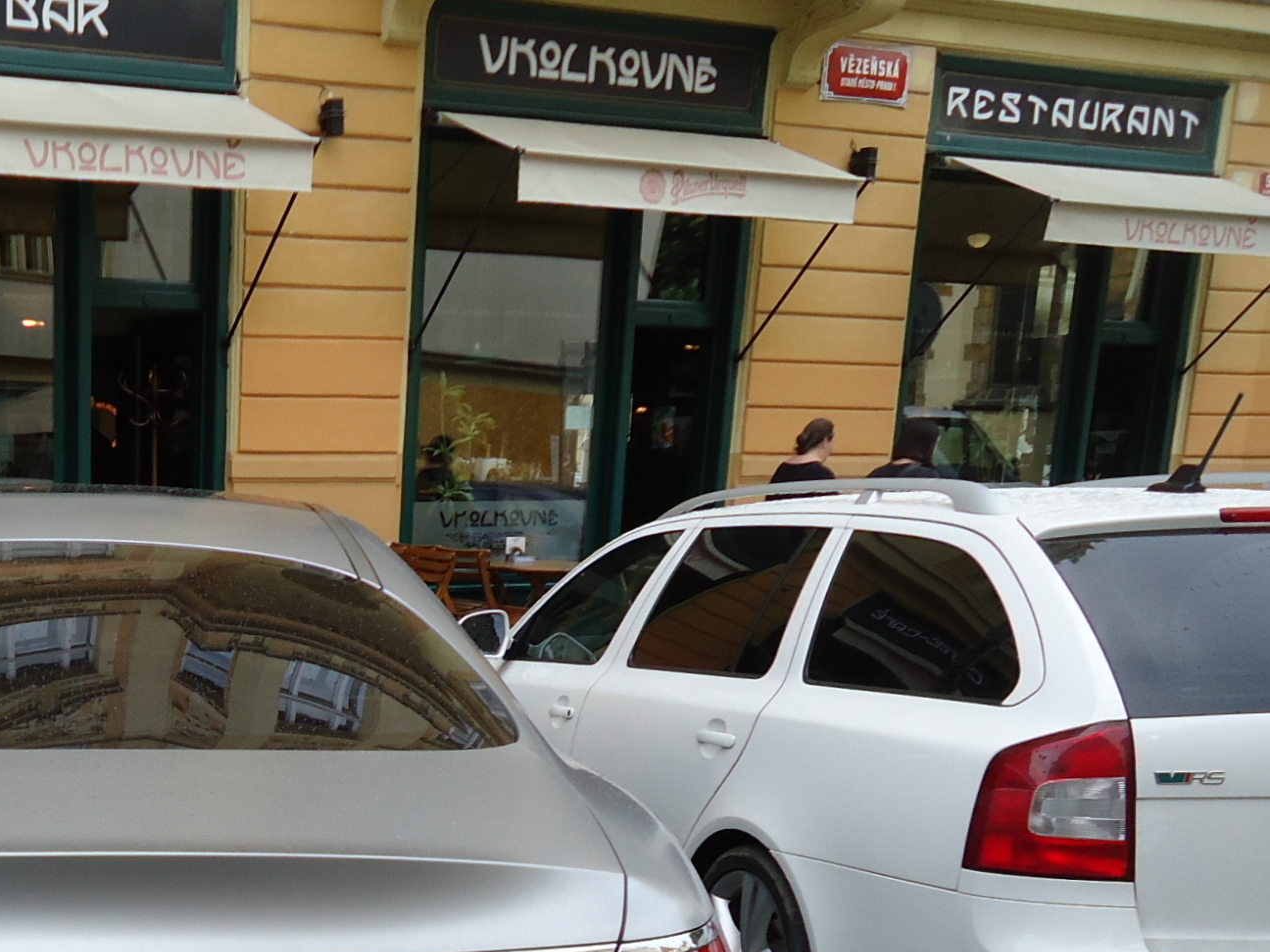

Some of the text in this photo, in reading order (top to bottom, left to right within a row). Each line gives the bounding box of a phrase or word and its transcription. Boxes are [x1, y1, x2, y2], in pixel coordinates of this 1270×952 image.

[6, 0, 109, 38] BAR
[840, 53, 900, 79] VĚZEŇSKÁ
[946, 86, 1199, 140] RESTAURANT
[23, 138, 246, 181] VKOLKOVNĚ
[1125, 217, 1257, 249] VKOLKOVNĚ
